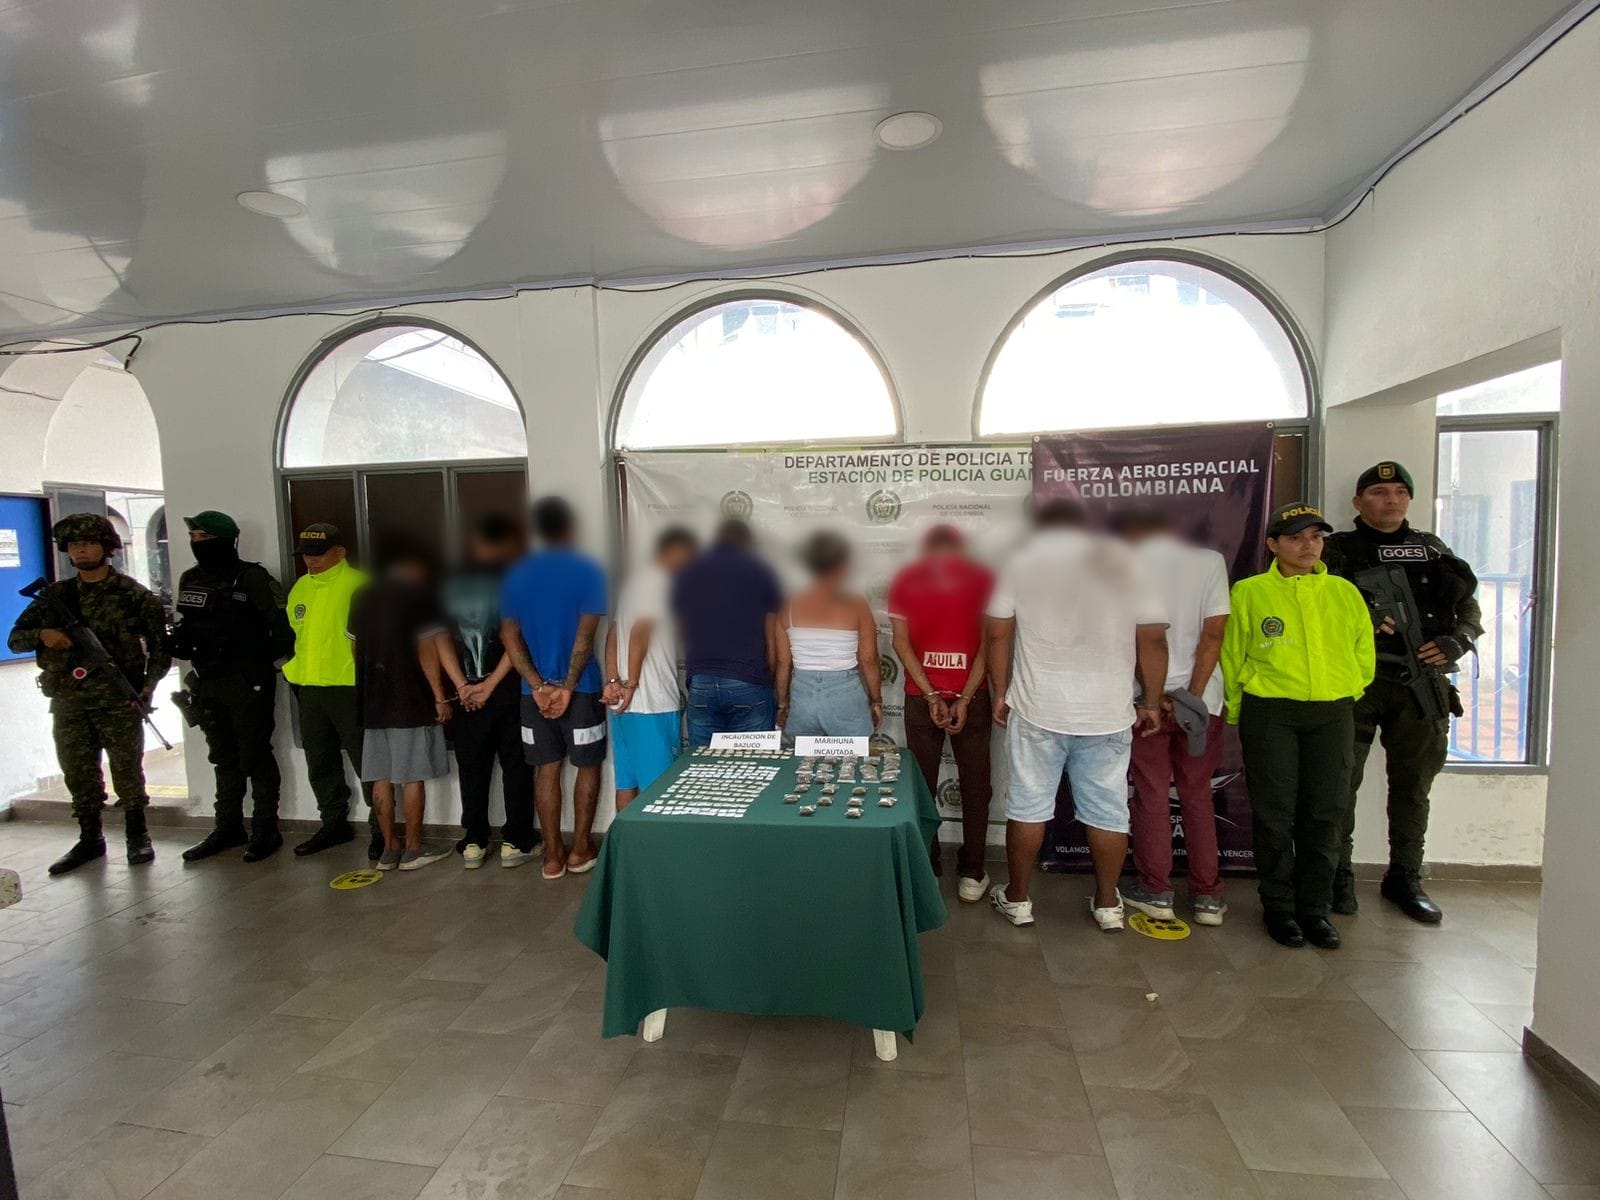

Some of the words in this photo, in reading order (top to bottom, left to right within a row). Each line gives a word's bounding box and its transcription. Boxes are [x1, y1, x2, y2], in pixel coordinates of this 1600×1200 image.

[784, 453, 913, 469] DEPARTAMENTO
[918, 453, 940, 466] DE
[945, 452, 1013, 466] POLICIA
[892, 470, 914, 483] DE
[919, 469, 986, 482] POLICIA
[1043, 467, 1114, 483] FUERZA
[1119, 459, 1260, 480] AEROESPACIAL
[1080, 477, 1225, 499] COLOMBIANA
[300, 531, 327, 540] LICIA
[1383, 548, 1424, 558] GOES
[721, 732, 766, 741] INCAUTACION
[814, 737, 854, 745] MARIHUNA
[813, 748, 854, 756] INCAUTADA
[1055, 845, 1091, 854] VOLAMOS
[1222, 849, 1254, 858] VENCER
